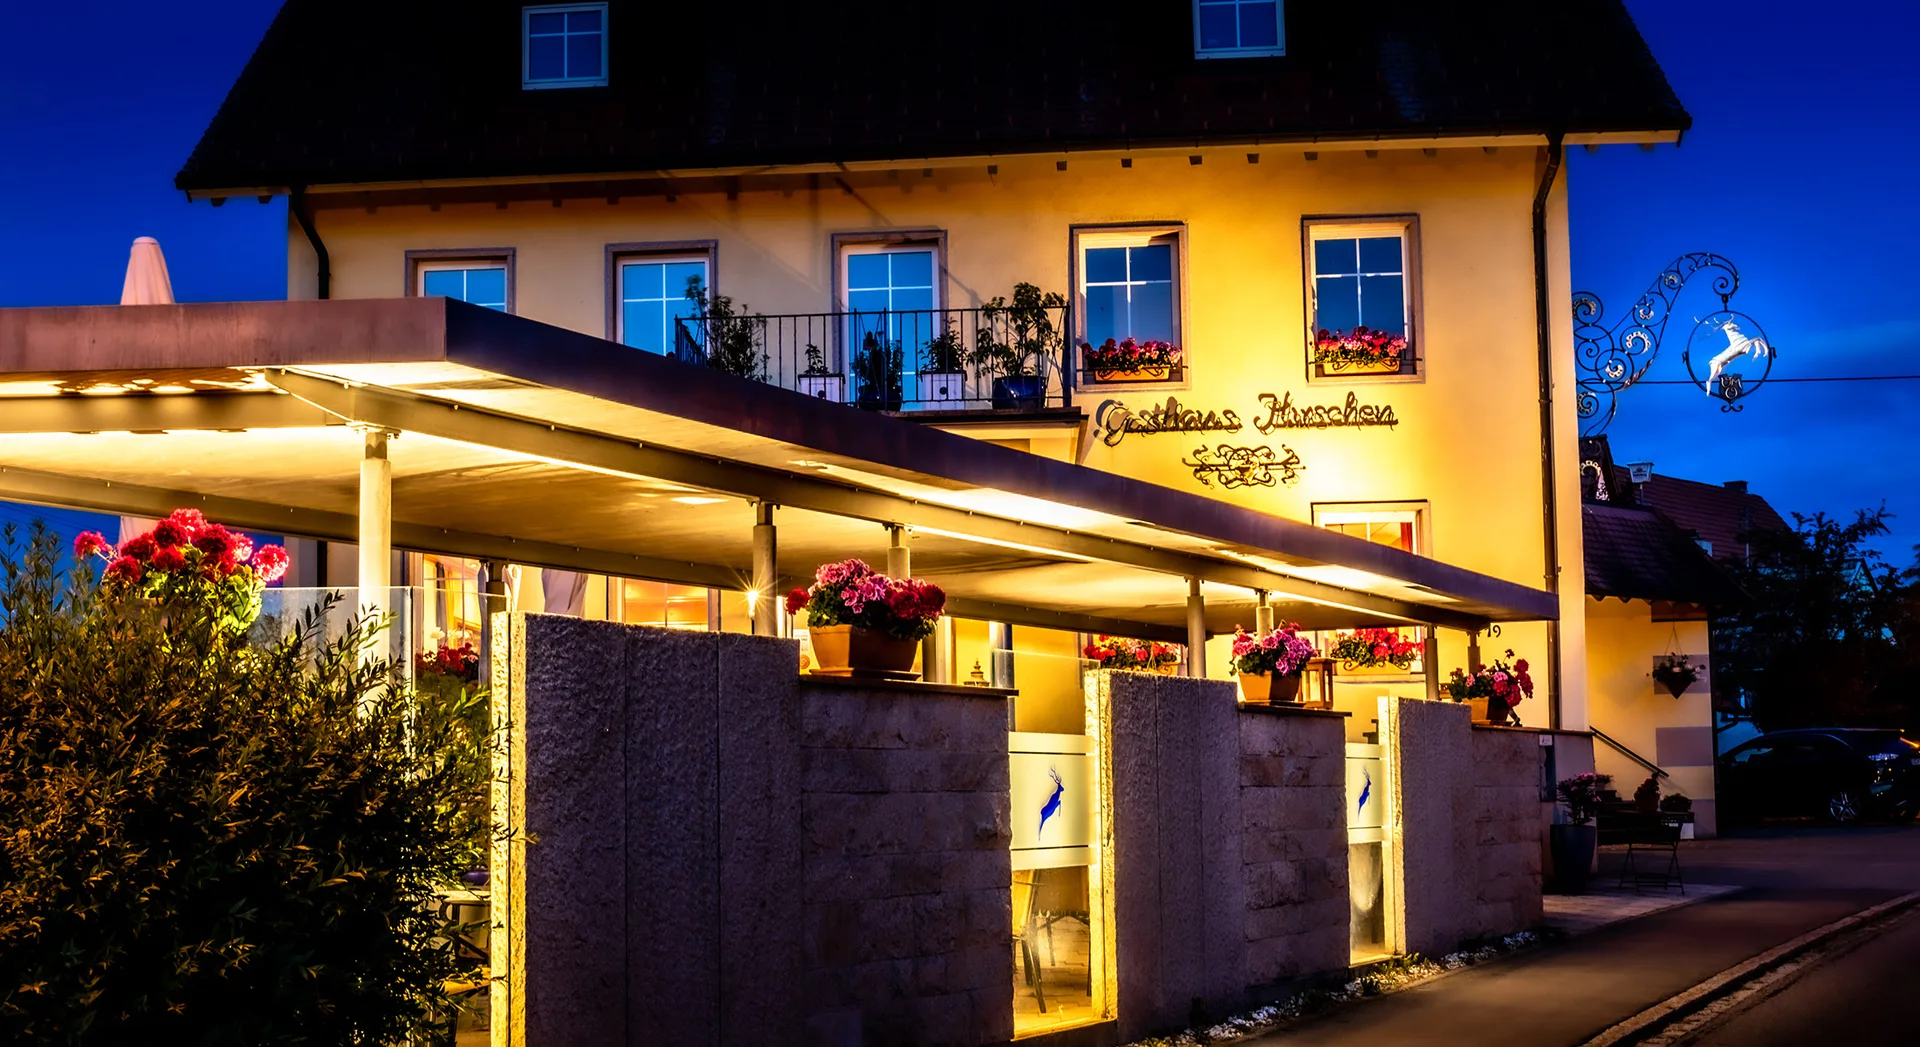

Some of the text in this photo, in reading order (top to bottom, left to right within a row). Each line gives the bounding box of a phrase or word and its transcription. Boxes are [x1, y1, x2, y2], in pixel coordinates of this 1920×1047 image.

[1094, 390, 1399, 447] Gasthaus Hirschen
[1487, 624, 1502, 638] 19
